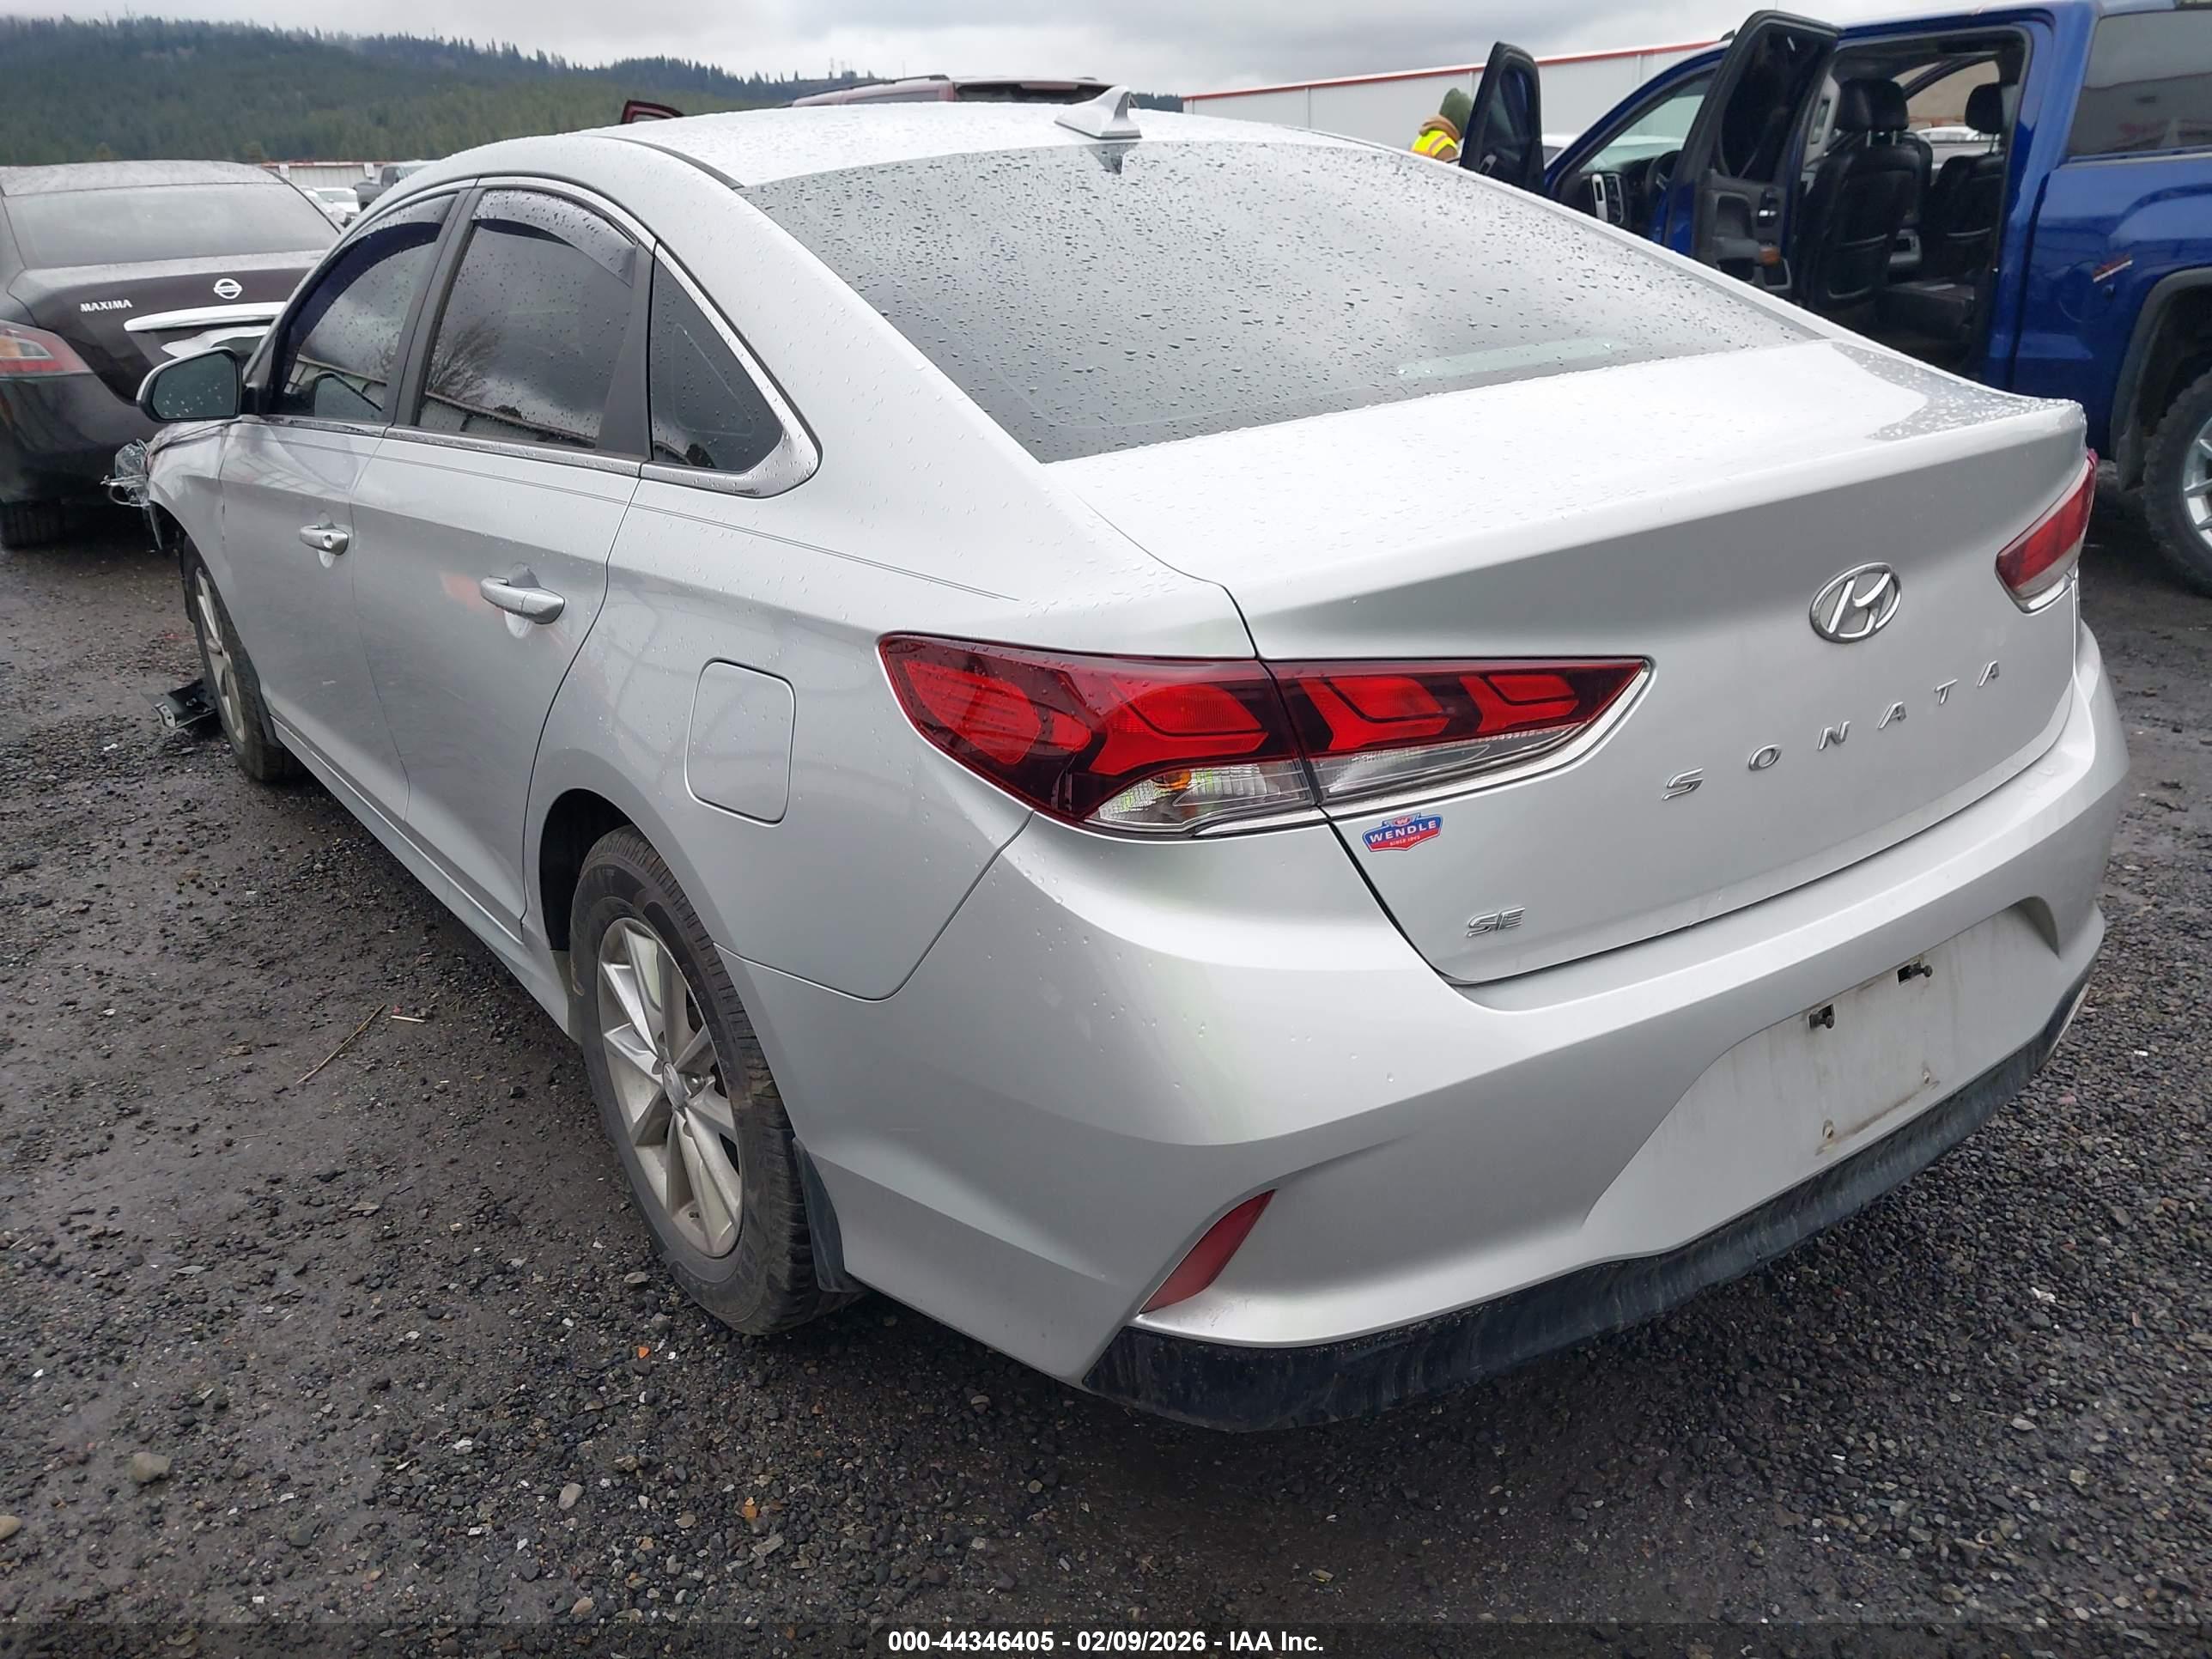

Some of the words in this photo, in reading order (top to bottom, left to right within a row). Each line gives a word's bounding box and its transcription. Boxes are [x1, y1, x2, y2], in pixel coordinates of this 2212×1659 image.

[80, 299, 132, 313] MAXIMA
[1662, 659, 2001, 801] SONATA
[1370, 820, 1437, 843] WENDLE
[1467, 907, 1526, 938] SE
